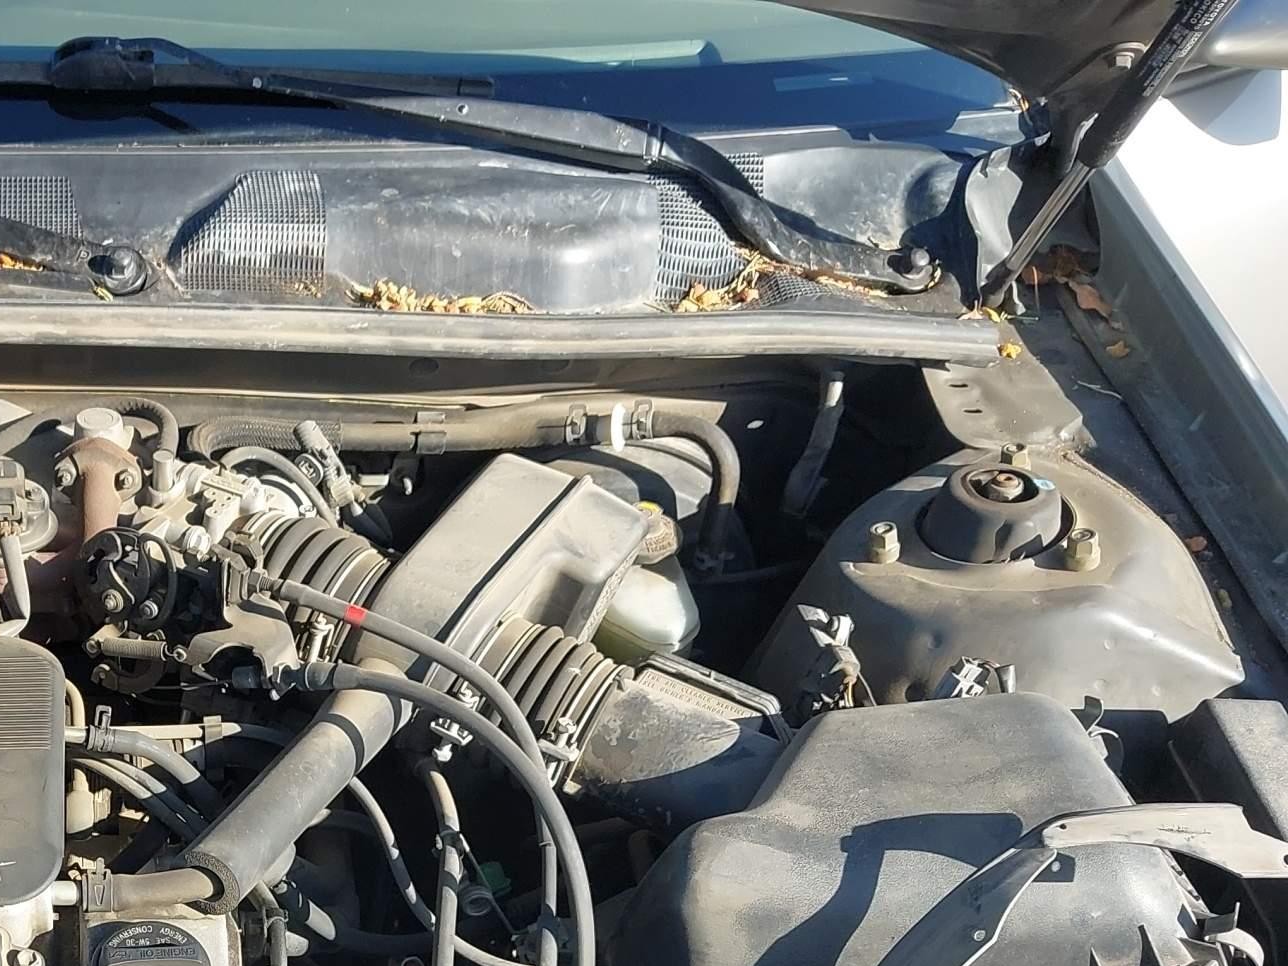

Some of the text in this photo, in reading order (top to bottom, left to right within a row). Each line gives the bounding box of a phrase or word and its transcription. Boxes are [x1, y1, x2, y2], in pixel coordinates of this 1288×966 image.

[108, 925, 188, 948] ENERGY CONSERVING
[155, 936, 171, 944] SAE
[136, 947, 196, 960] ENGINE OIL
